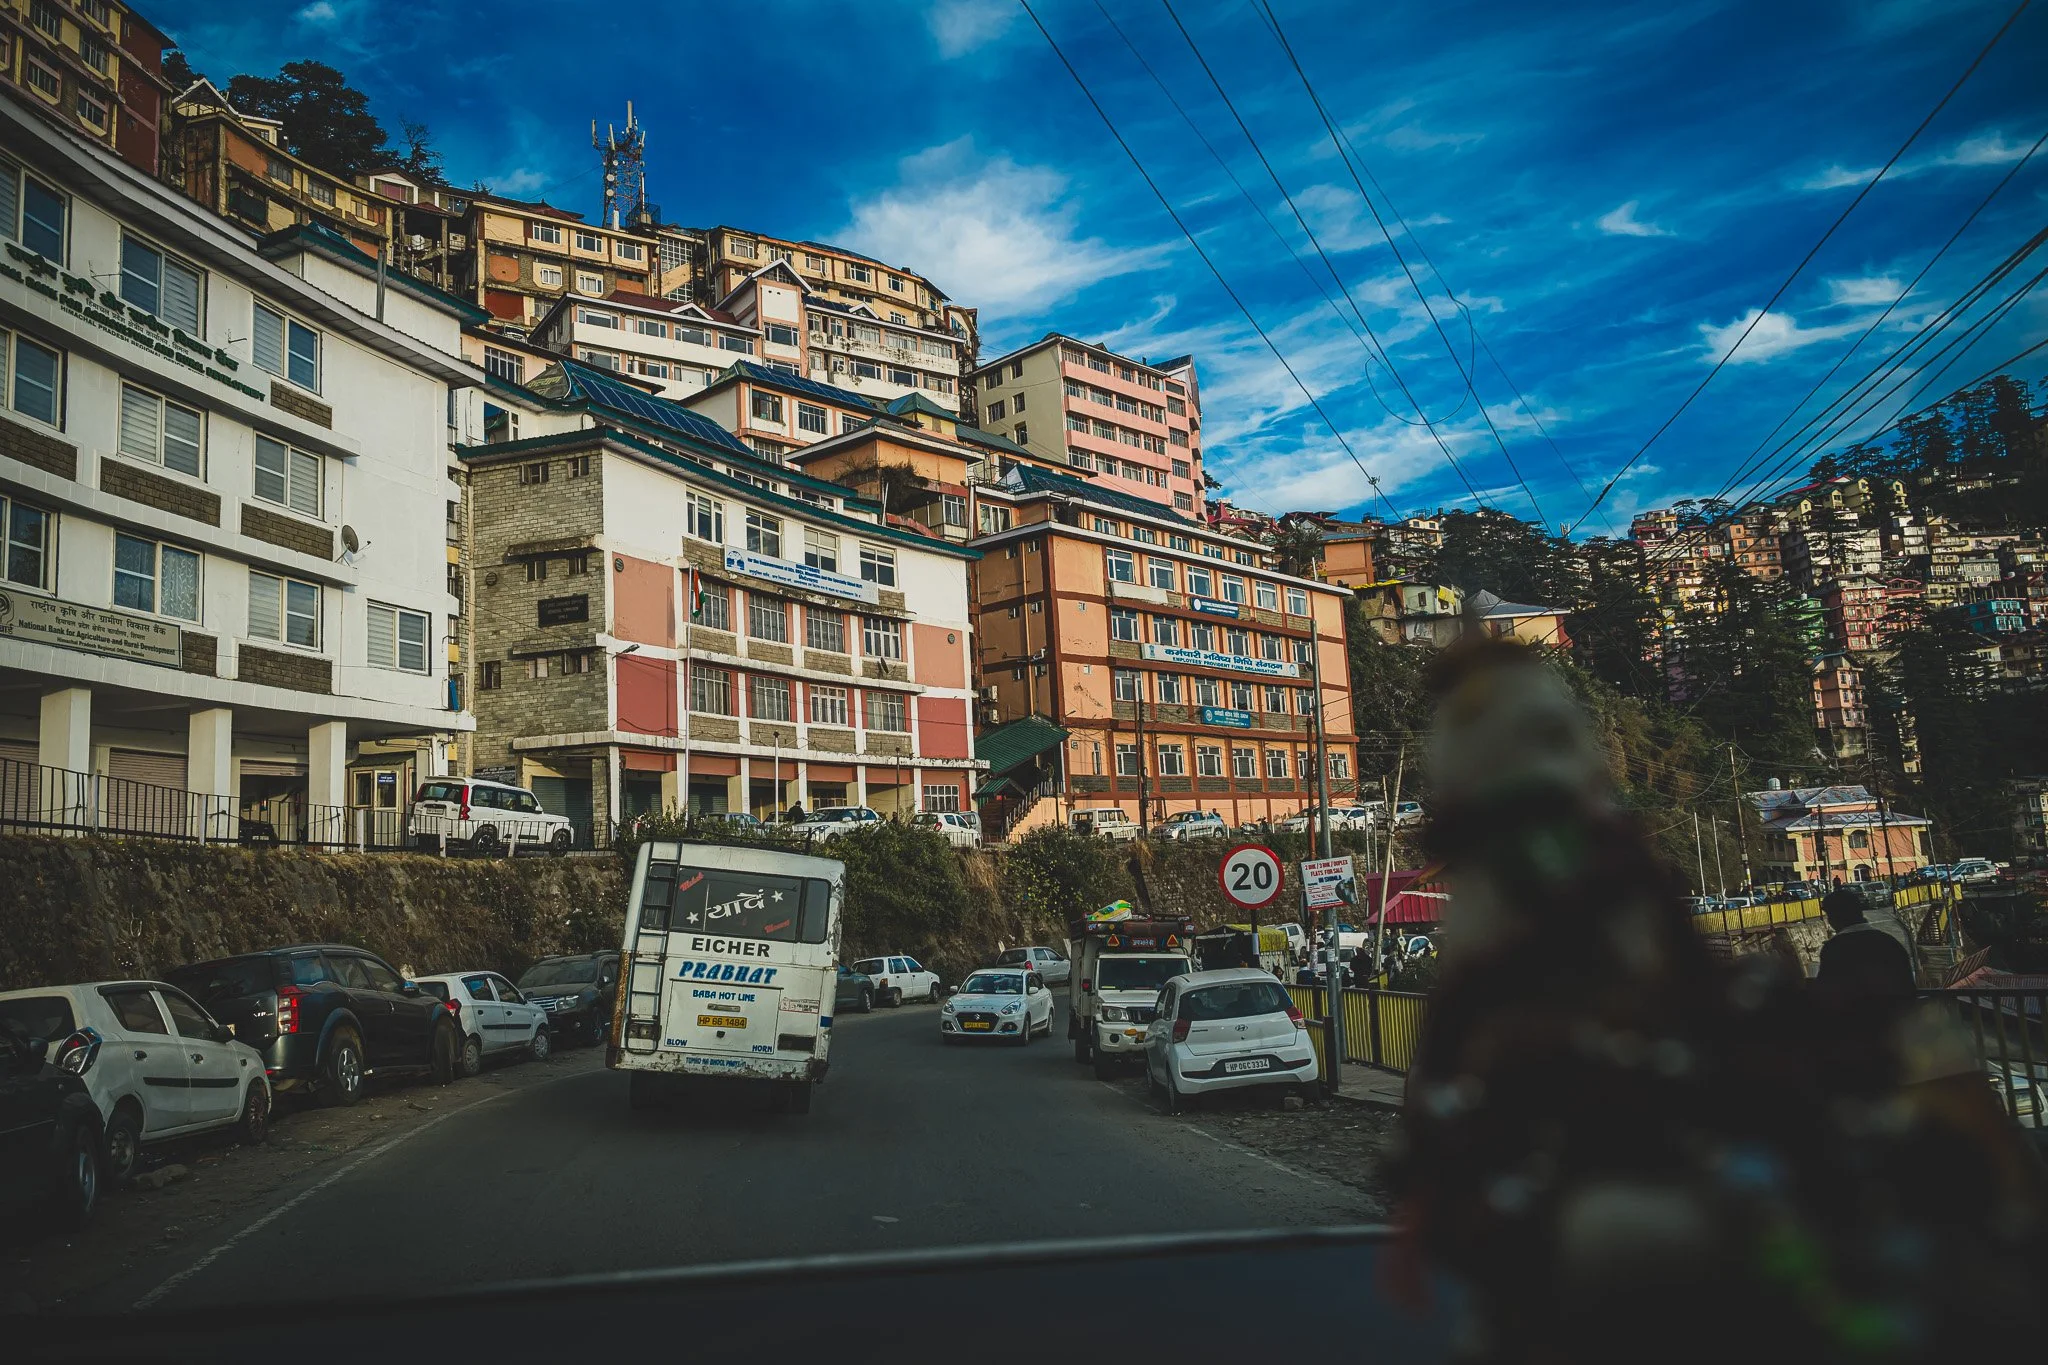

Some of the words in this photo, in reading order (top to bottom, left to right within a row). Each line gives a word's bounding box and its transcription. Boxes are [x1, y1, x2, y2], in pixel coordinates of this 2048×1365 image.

[60, 305, 97, 328] HIMACHAL
[98, 324, 130, 343] PRADESH
[30, 600, 56, 613] राष्ट्रीय
[60, 606, 77, 617] कृषि
[81, 609, 96, 620] और
[99, 614, 123, 627] ग्रामीण
[126, 618, 150, 632] विकास
[153, 624, 166, 635] बैंक
[19, 619, 47, 632] National
[48, 625, 65, 636] Bank
[66, 629, 75, 637] for
[77, 630, 111, 643] Agriculture
[111, 638, 123, 646] and
[124, 639, 140, 649] Rural
[140, 642, 176, 656] Development
[1164, 648, 1201, 659] कर्मचारी
[1203, 652, 1230, 663] भविष्य
[1203, 660, 1230, 668] PROVIDENT
[1231, 861, 1273, 891] 20
[1310, 869, 1323, 877] FLATS
[691, 937, 771, 958] EICHER
[679, 961, 778, 984] PRABHAT
[693, 989, 717, 999] BABA
[719, 992, 736, 1001] HOT
[738, 994, 755, 1002] LINE
[699, 1017, 710, 1025] HP
[725, 1018, 745, 1027] 1484
[666, 1038, 688, 1046] BLOW
[752, 1044, 773, 1053] HORN
[1229, 1063, 1237, 1071] HP
[1252, 1060, 1268, 1069] 3334
